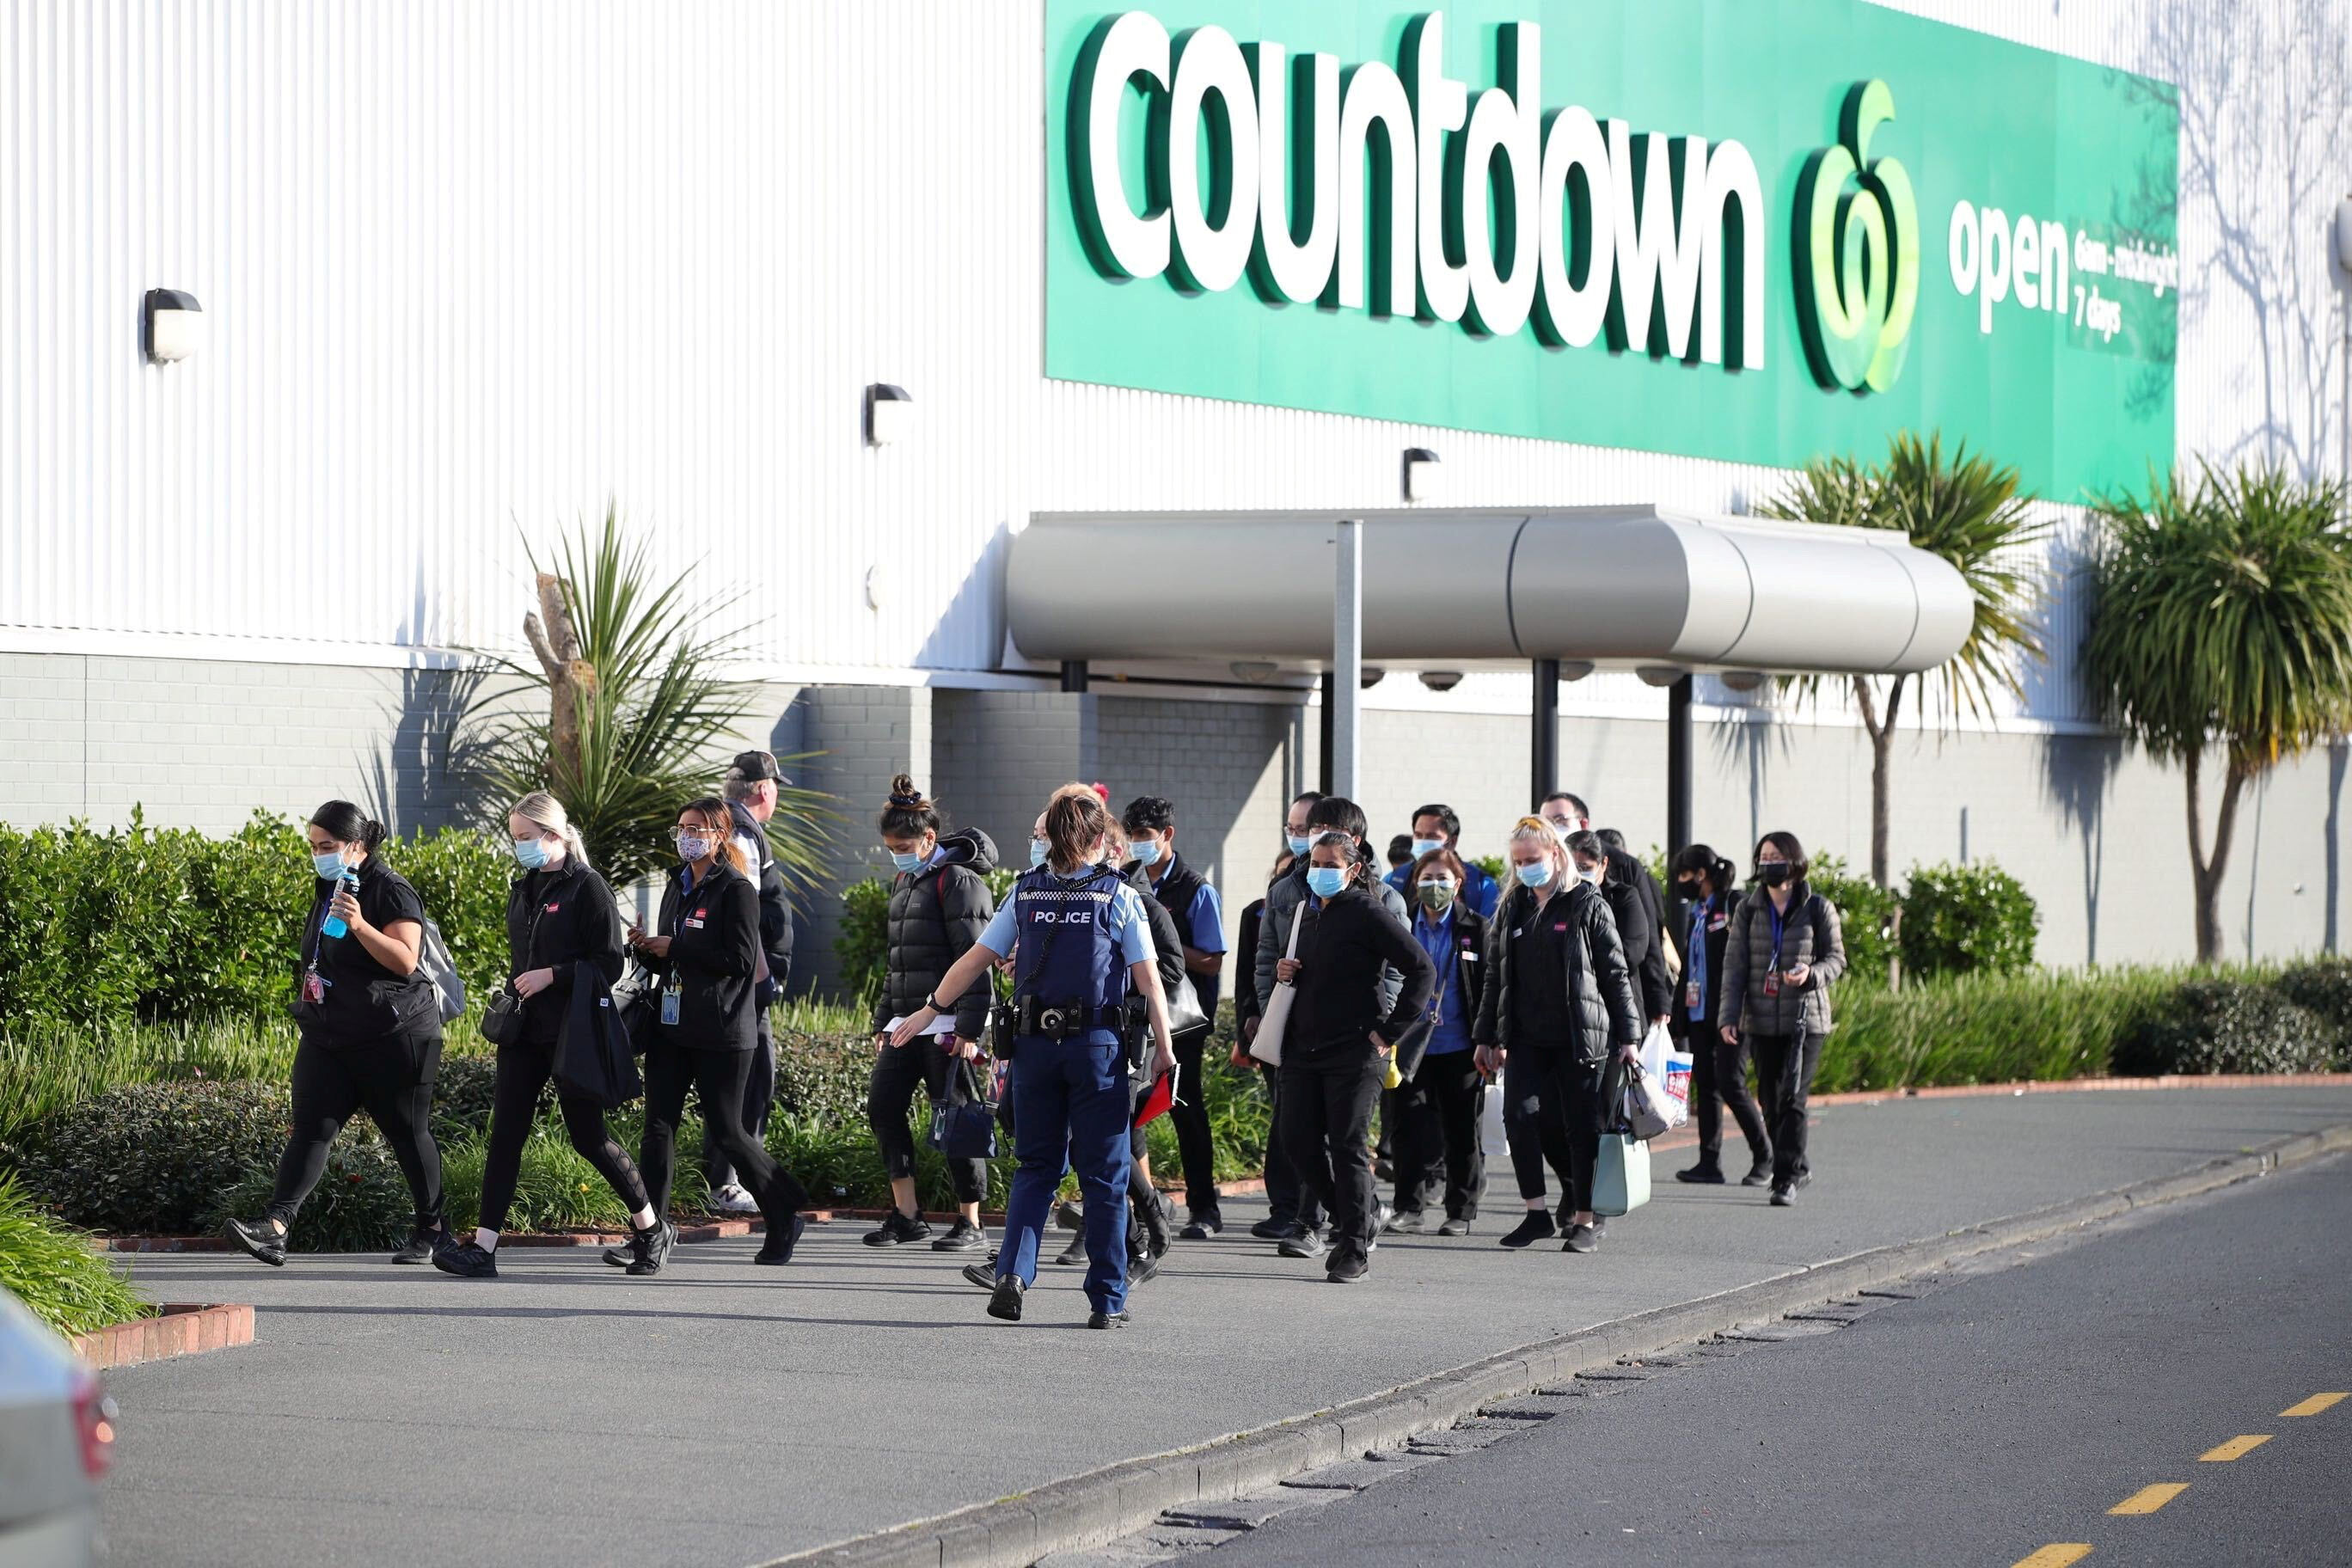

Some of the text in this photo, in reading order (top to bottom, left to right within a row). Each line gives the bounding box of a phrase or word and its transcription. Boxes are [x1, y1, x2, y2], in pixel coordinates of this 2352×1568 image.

[1089, 9, 1765, 371] countdown
[1948, 199, 2069, 334] open
[2074, 285, 2122, 344] 7 days
